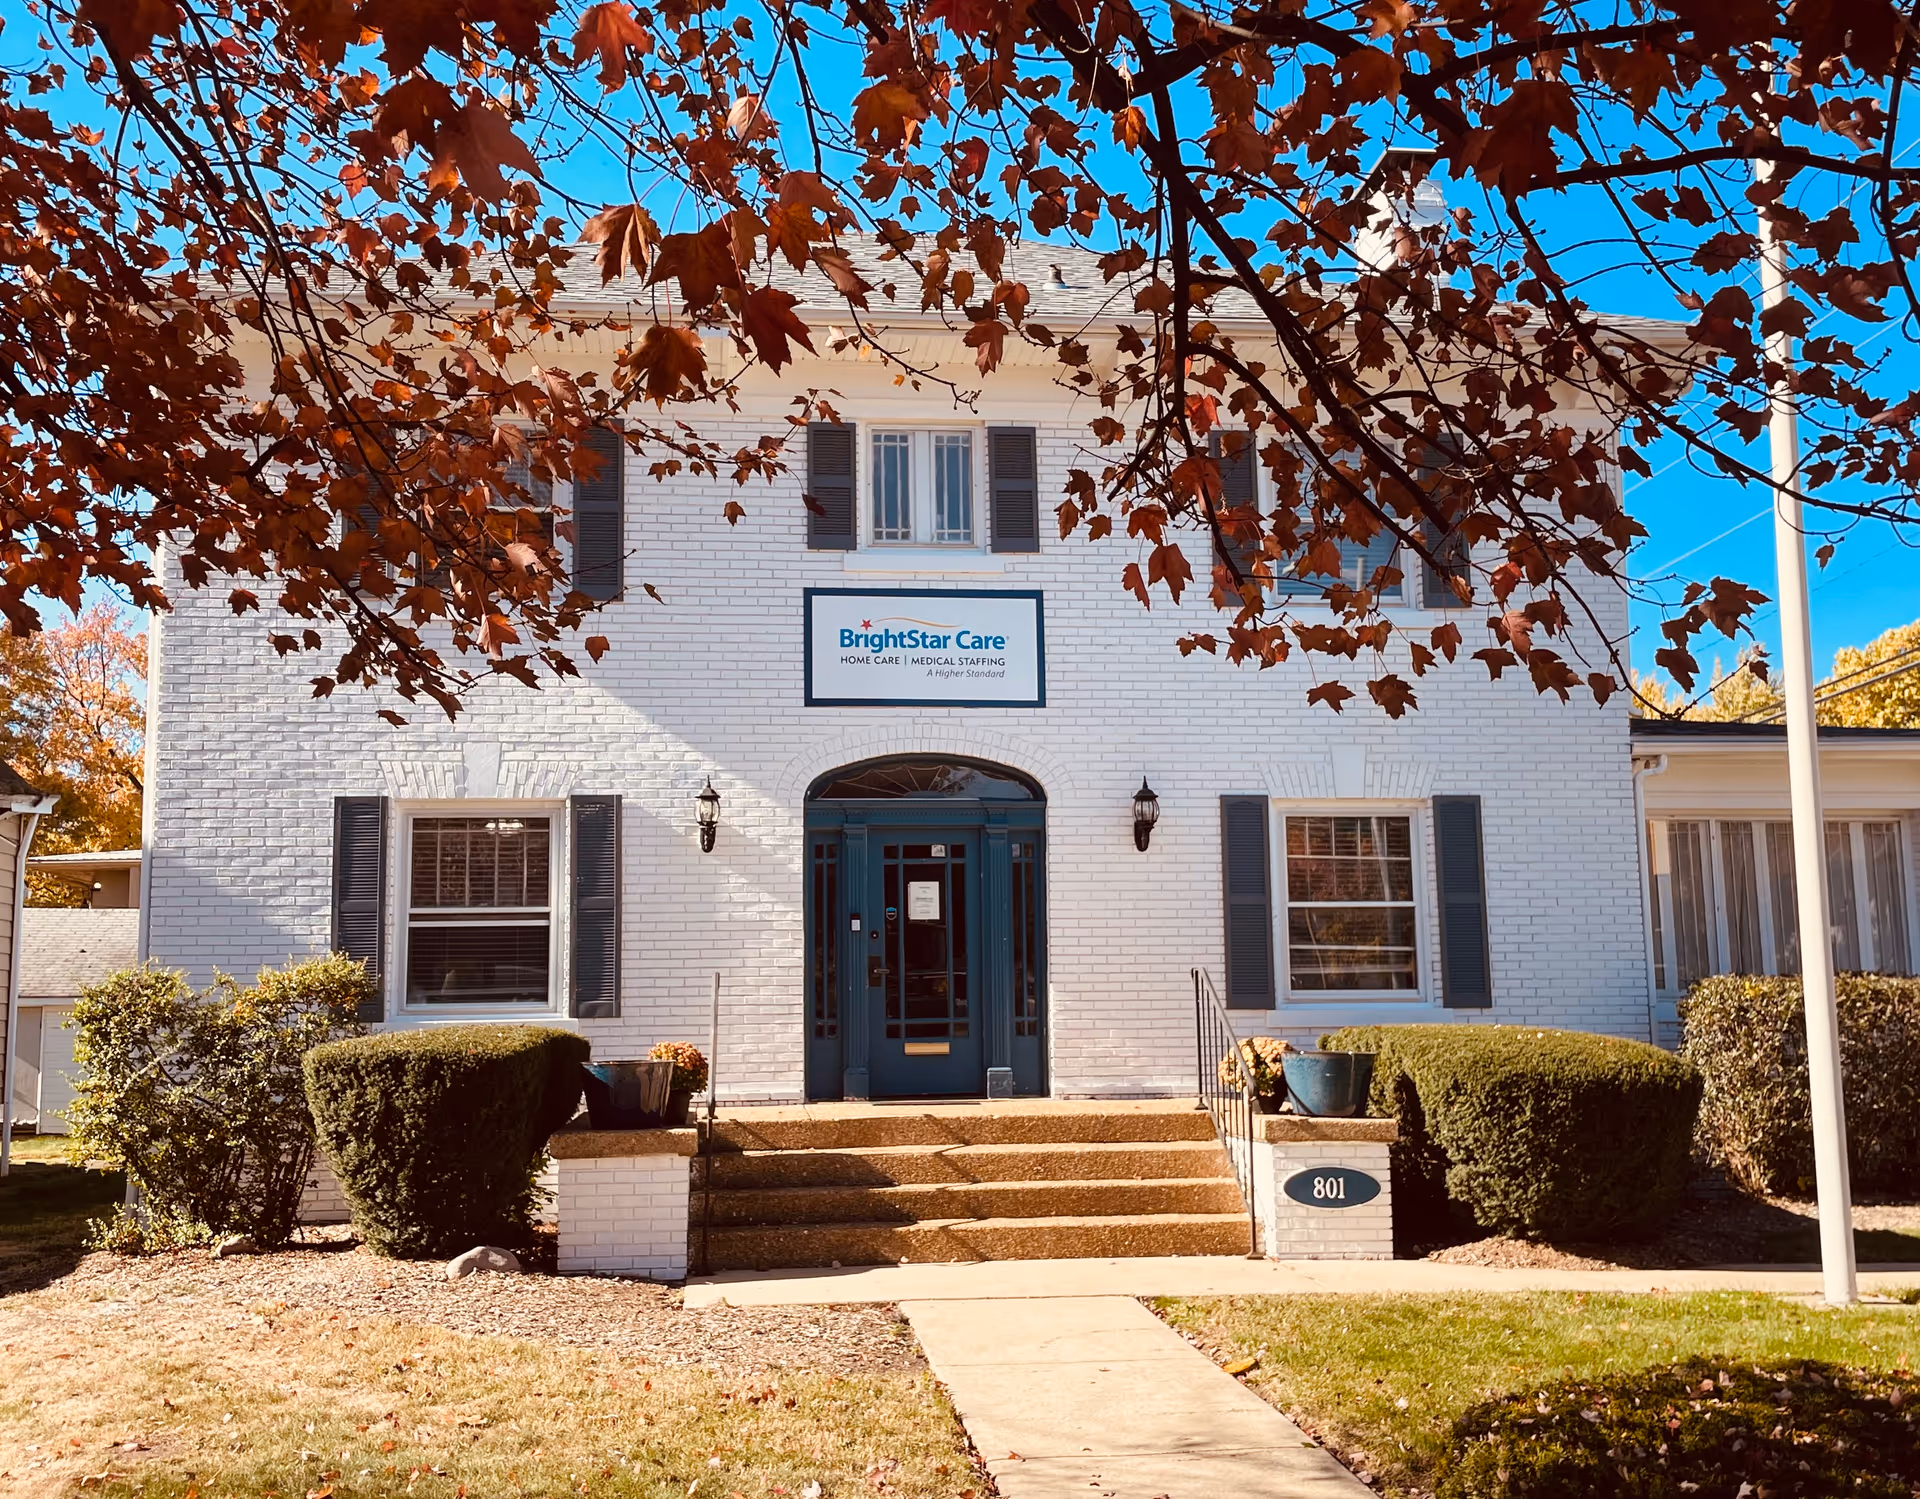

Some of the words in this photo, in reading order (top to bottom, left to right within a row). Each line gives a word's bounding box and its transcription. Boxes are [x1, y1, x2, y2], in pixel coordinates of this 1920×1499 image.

[840, 628, 951, 653] BrightStar
[955, 630, 1006, 650] Care
[840, 655, 871, 665] HOME
[873, 656, 900, 665] CARE
[911, 657, 956, 666] MEDICAL
[958, 657, 1006, 667] STAFFING
[926, 669, 933, 677] A
[935, 669, 964, 679] Higher
[966, 669, 1005, 678] Standard
[1313, 1176, 1345, 1199] 801
